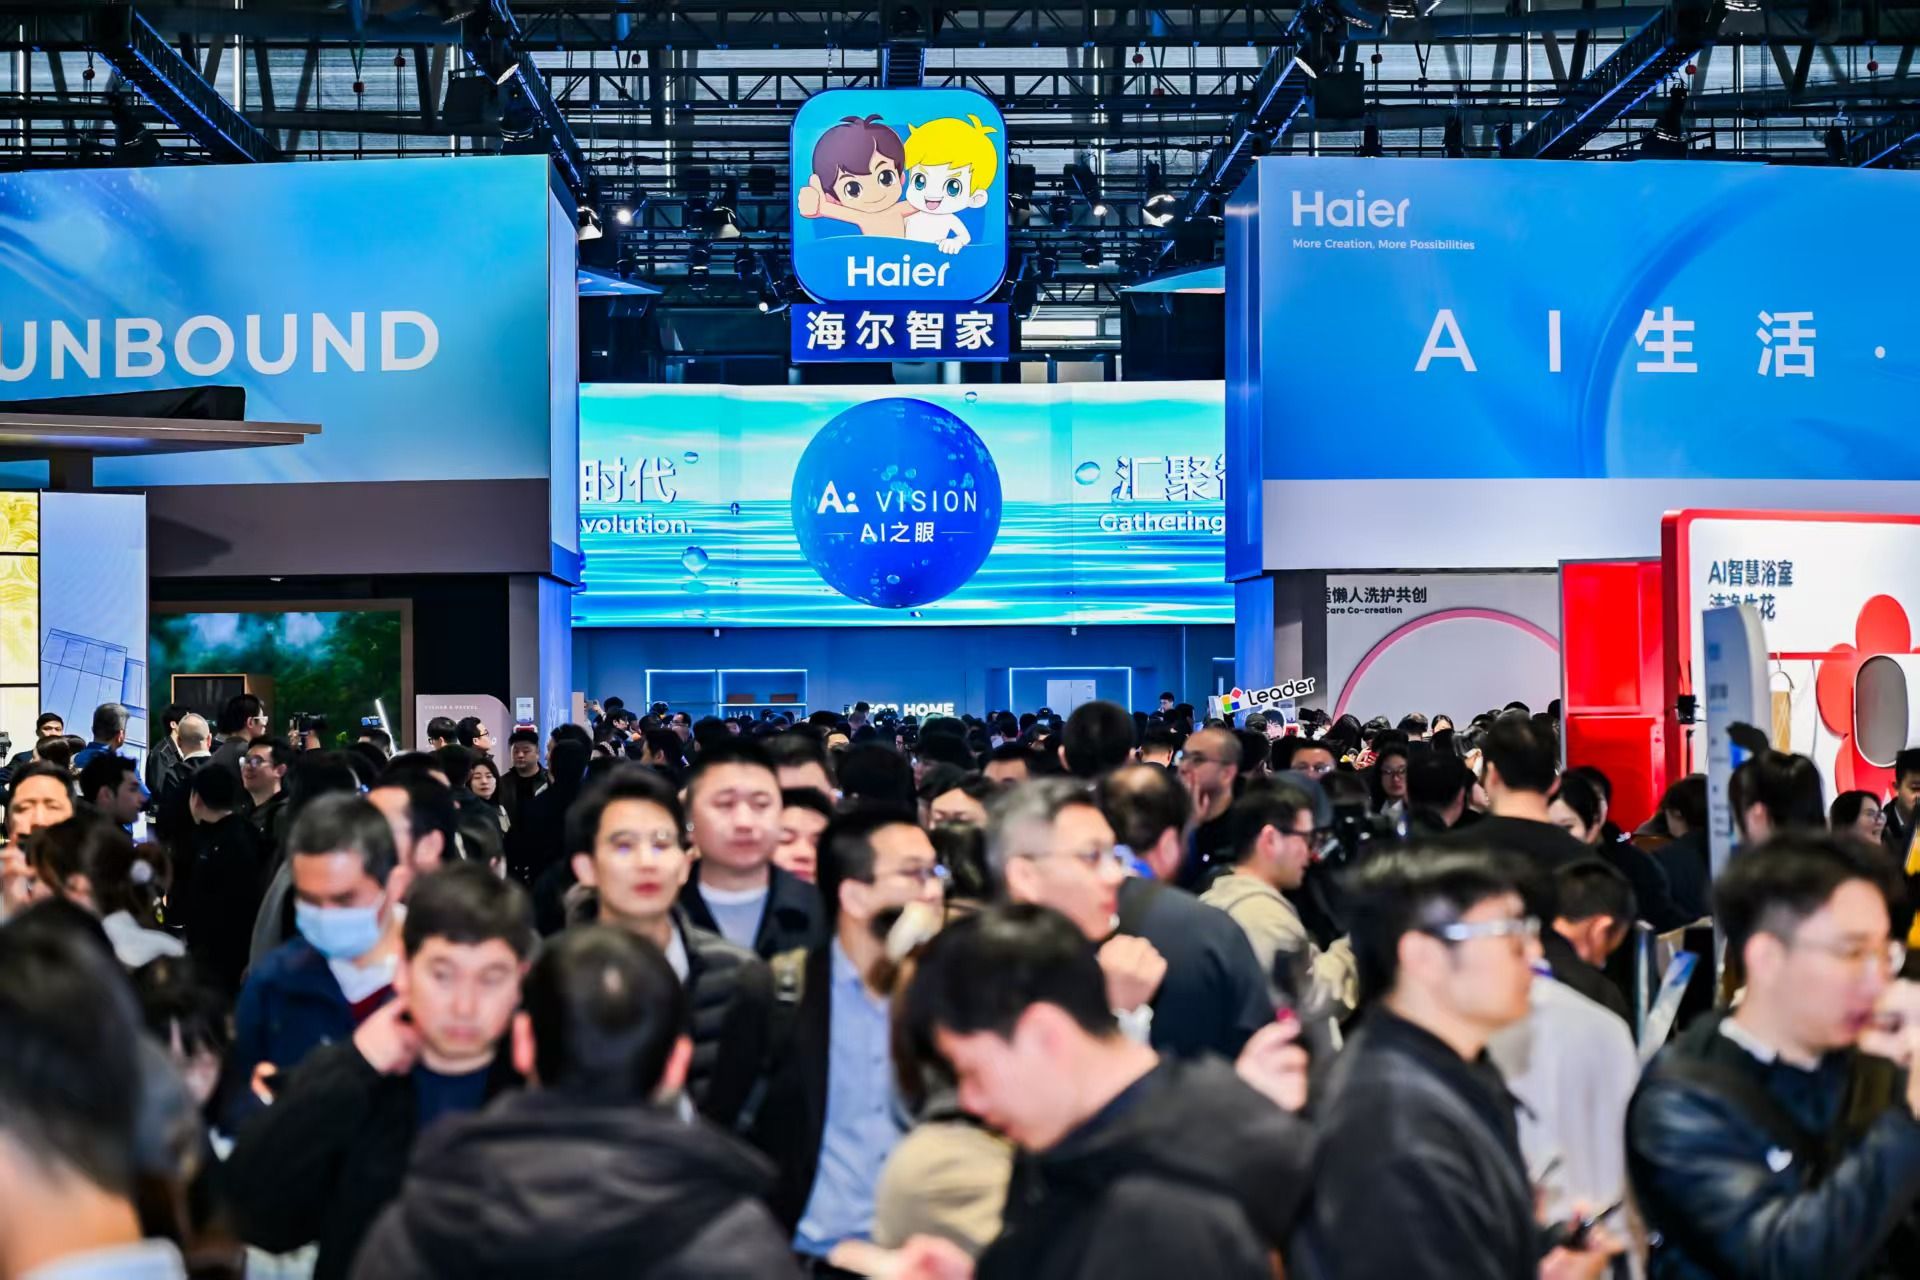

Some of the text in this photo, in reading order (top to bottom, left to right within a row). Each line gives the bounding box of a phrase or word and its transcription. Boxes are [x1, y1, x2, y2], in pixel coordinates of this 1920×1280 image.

[1292, 189, 1410, 228] Haier
[1292, 239, 1321, 249] More
[1378, 239, 1407, 250] More
[1410, 239, 1476, 251] Possibilities
[847, 254, 951, 287] Haier
[805, 310, 995, 350] 海尔智家
[0, 310, 440, 383] UNBOUND
[875, 490, 977, 513] VISION
[860, 521, 935, 543] AI之眼
[1099, 511, 1225, 535] Gathering
[1707, 558, 1793, 587] AI智慧浴室
[1347, 605, 1403, 615] Co-creation
[1247, 678, 1314, 705] Leader
[903, 702, 954, 716] HOME
